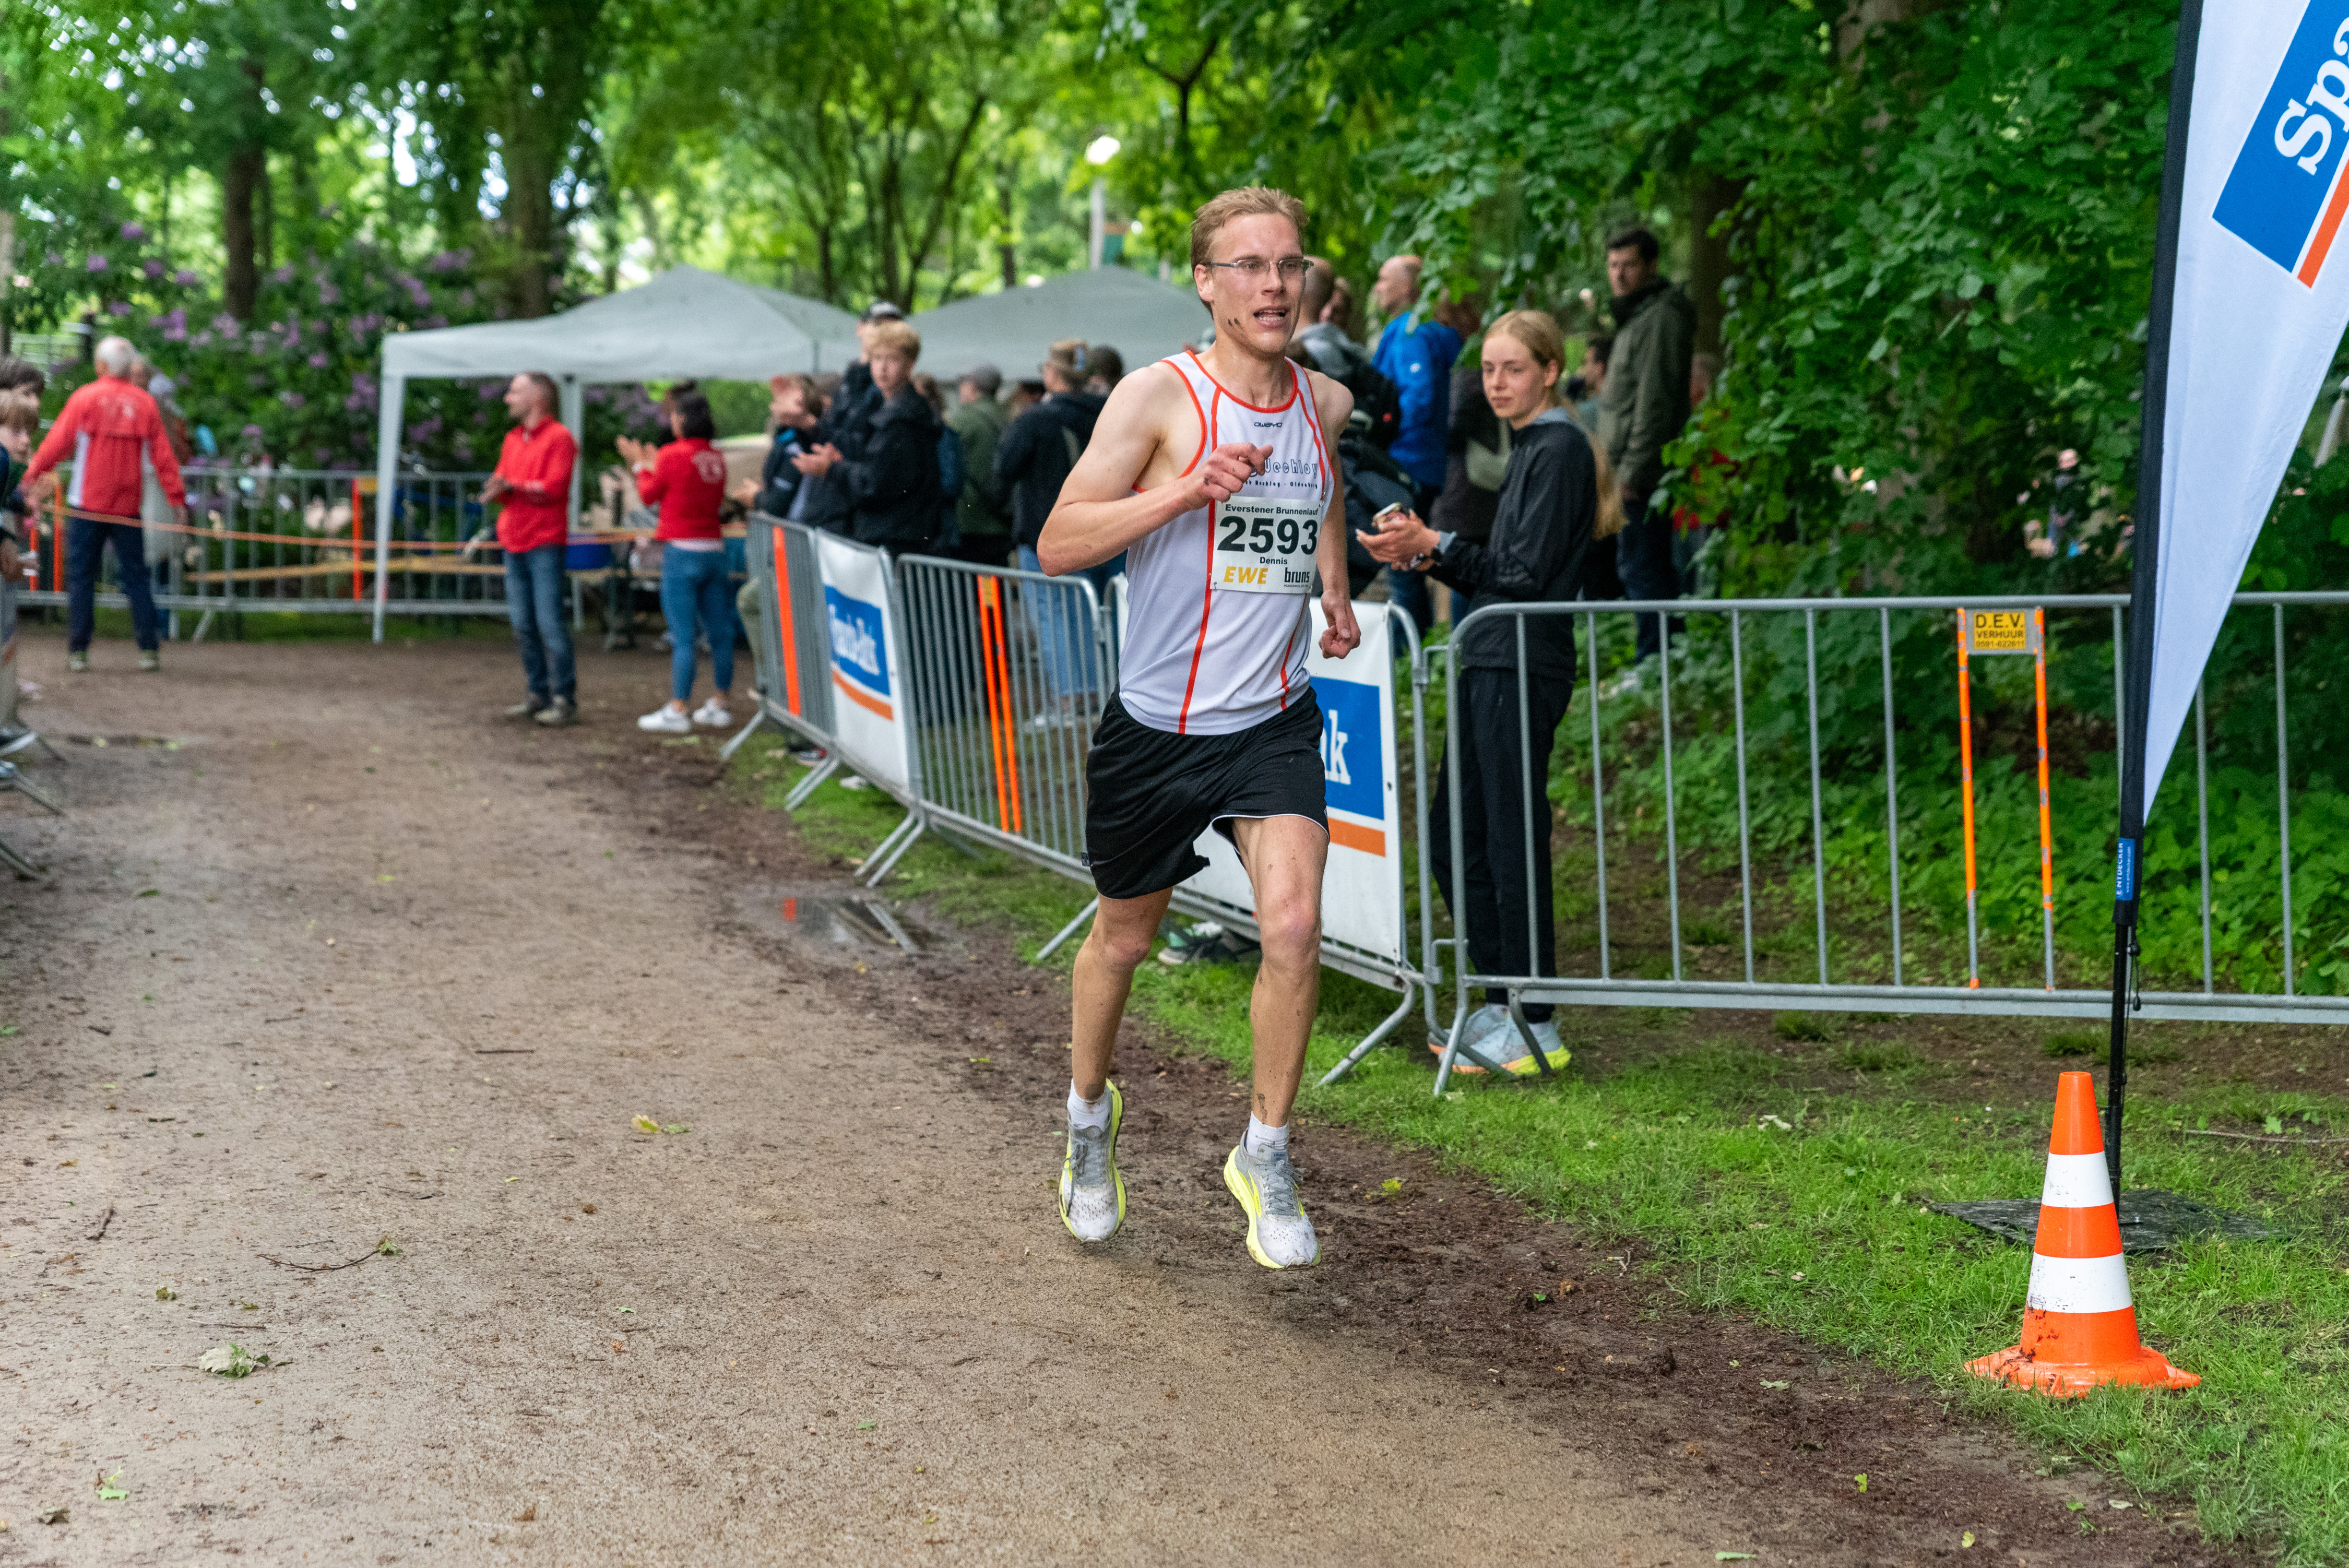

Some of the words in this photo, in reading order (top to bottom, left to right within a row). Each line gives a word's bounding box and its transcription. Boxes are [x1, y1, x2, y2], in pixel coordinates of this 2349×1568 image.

[1225, 504, 1274, 513] Everstener
[1276, 506, 1319, 515] Brunnenlauf
[1217, 516, 1318, 555] 2593
[1224, 566, 1268, 585] EWE
[1285, 567, 1310, 583] bruns
[1975, 614, 2024, 628] D.E.V.
[1976, 630, 2024, 638] VERHUUR
